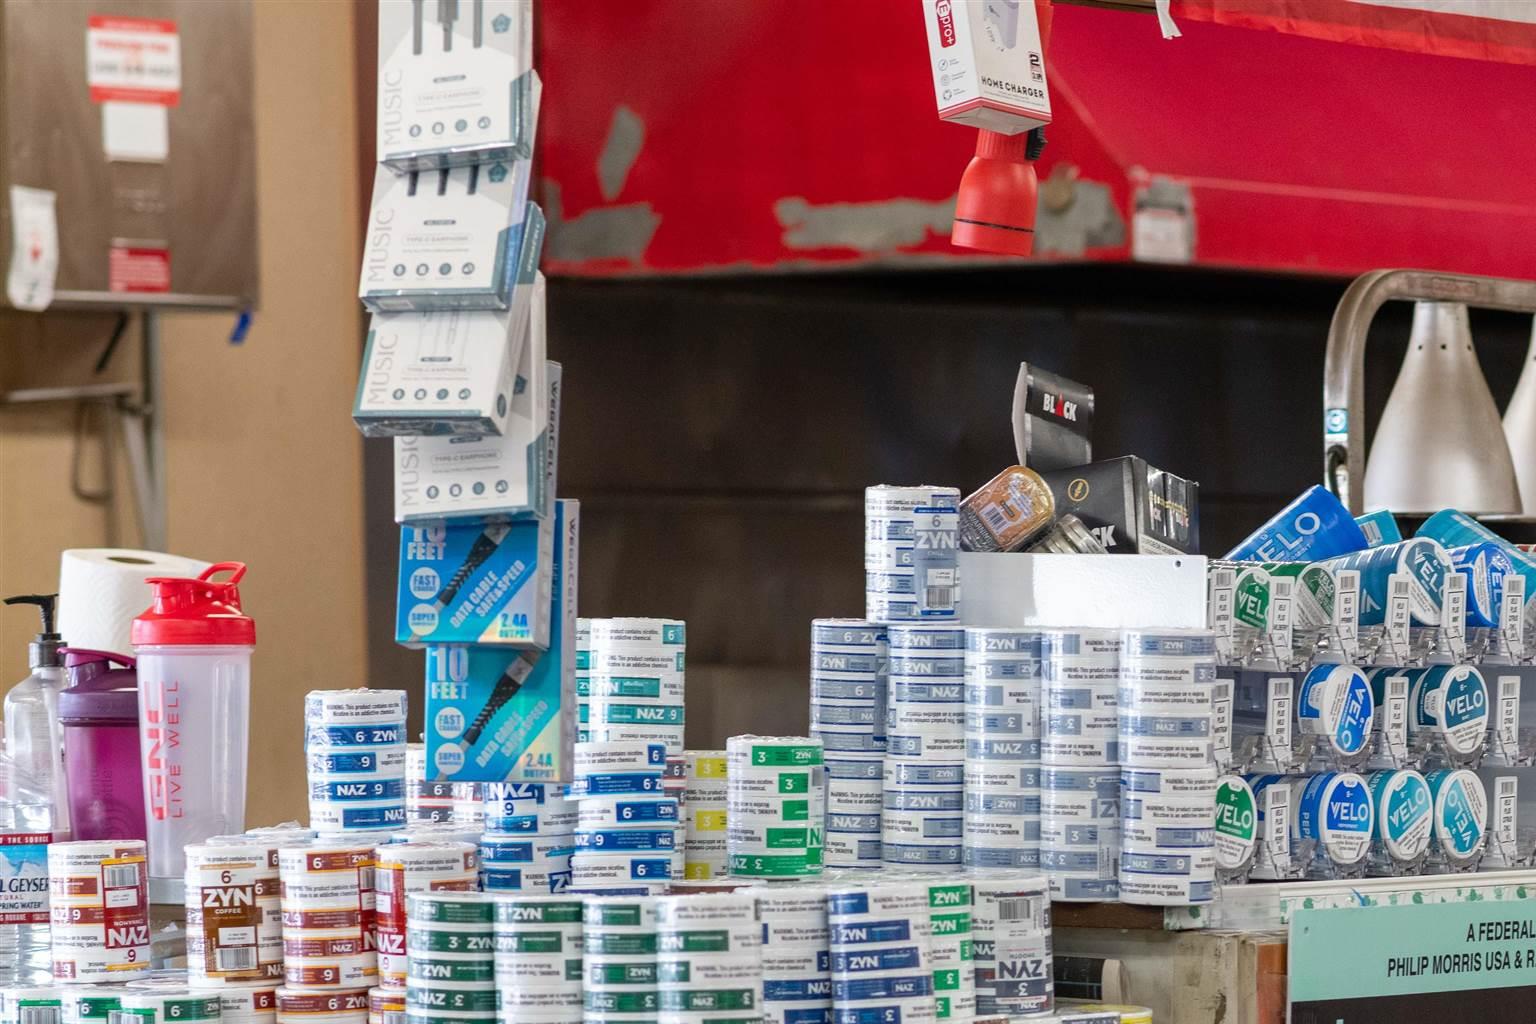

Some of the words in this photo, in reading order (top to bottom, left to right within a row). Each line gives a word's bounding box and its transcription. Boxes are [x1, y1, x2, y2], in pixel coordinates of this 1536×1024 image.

[982, 75, 1004, 91] HOME
[1005, 80, 1045, 100] CHARGER
[367, 207, 396, 284] MUSIC
[431, 648, 469, 683] 10
[432, 681, 469, 700] FEET
[1446, 690, 1483, 717] VELO
[166, 679, 181, 748] WELL
[171, 758, 184, 819] LIVE
[1331, 801, 1369, 821] VELO
[203, 887, 253, 907] ZYN
[1467, 924, 1475, 942] A
[1479, 920, 1536, 942] FEDERAL
[1388, 957, 1429, 977] PHILIP
[1433, 953, 1482, 974] MORRIS
[1486, 951, 1511, 971] USA
[1514, 951, 1522, 969] &
